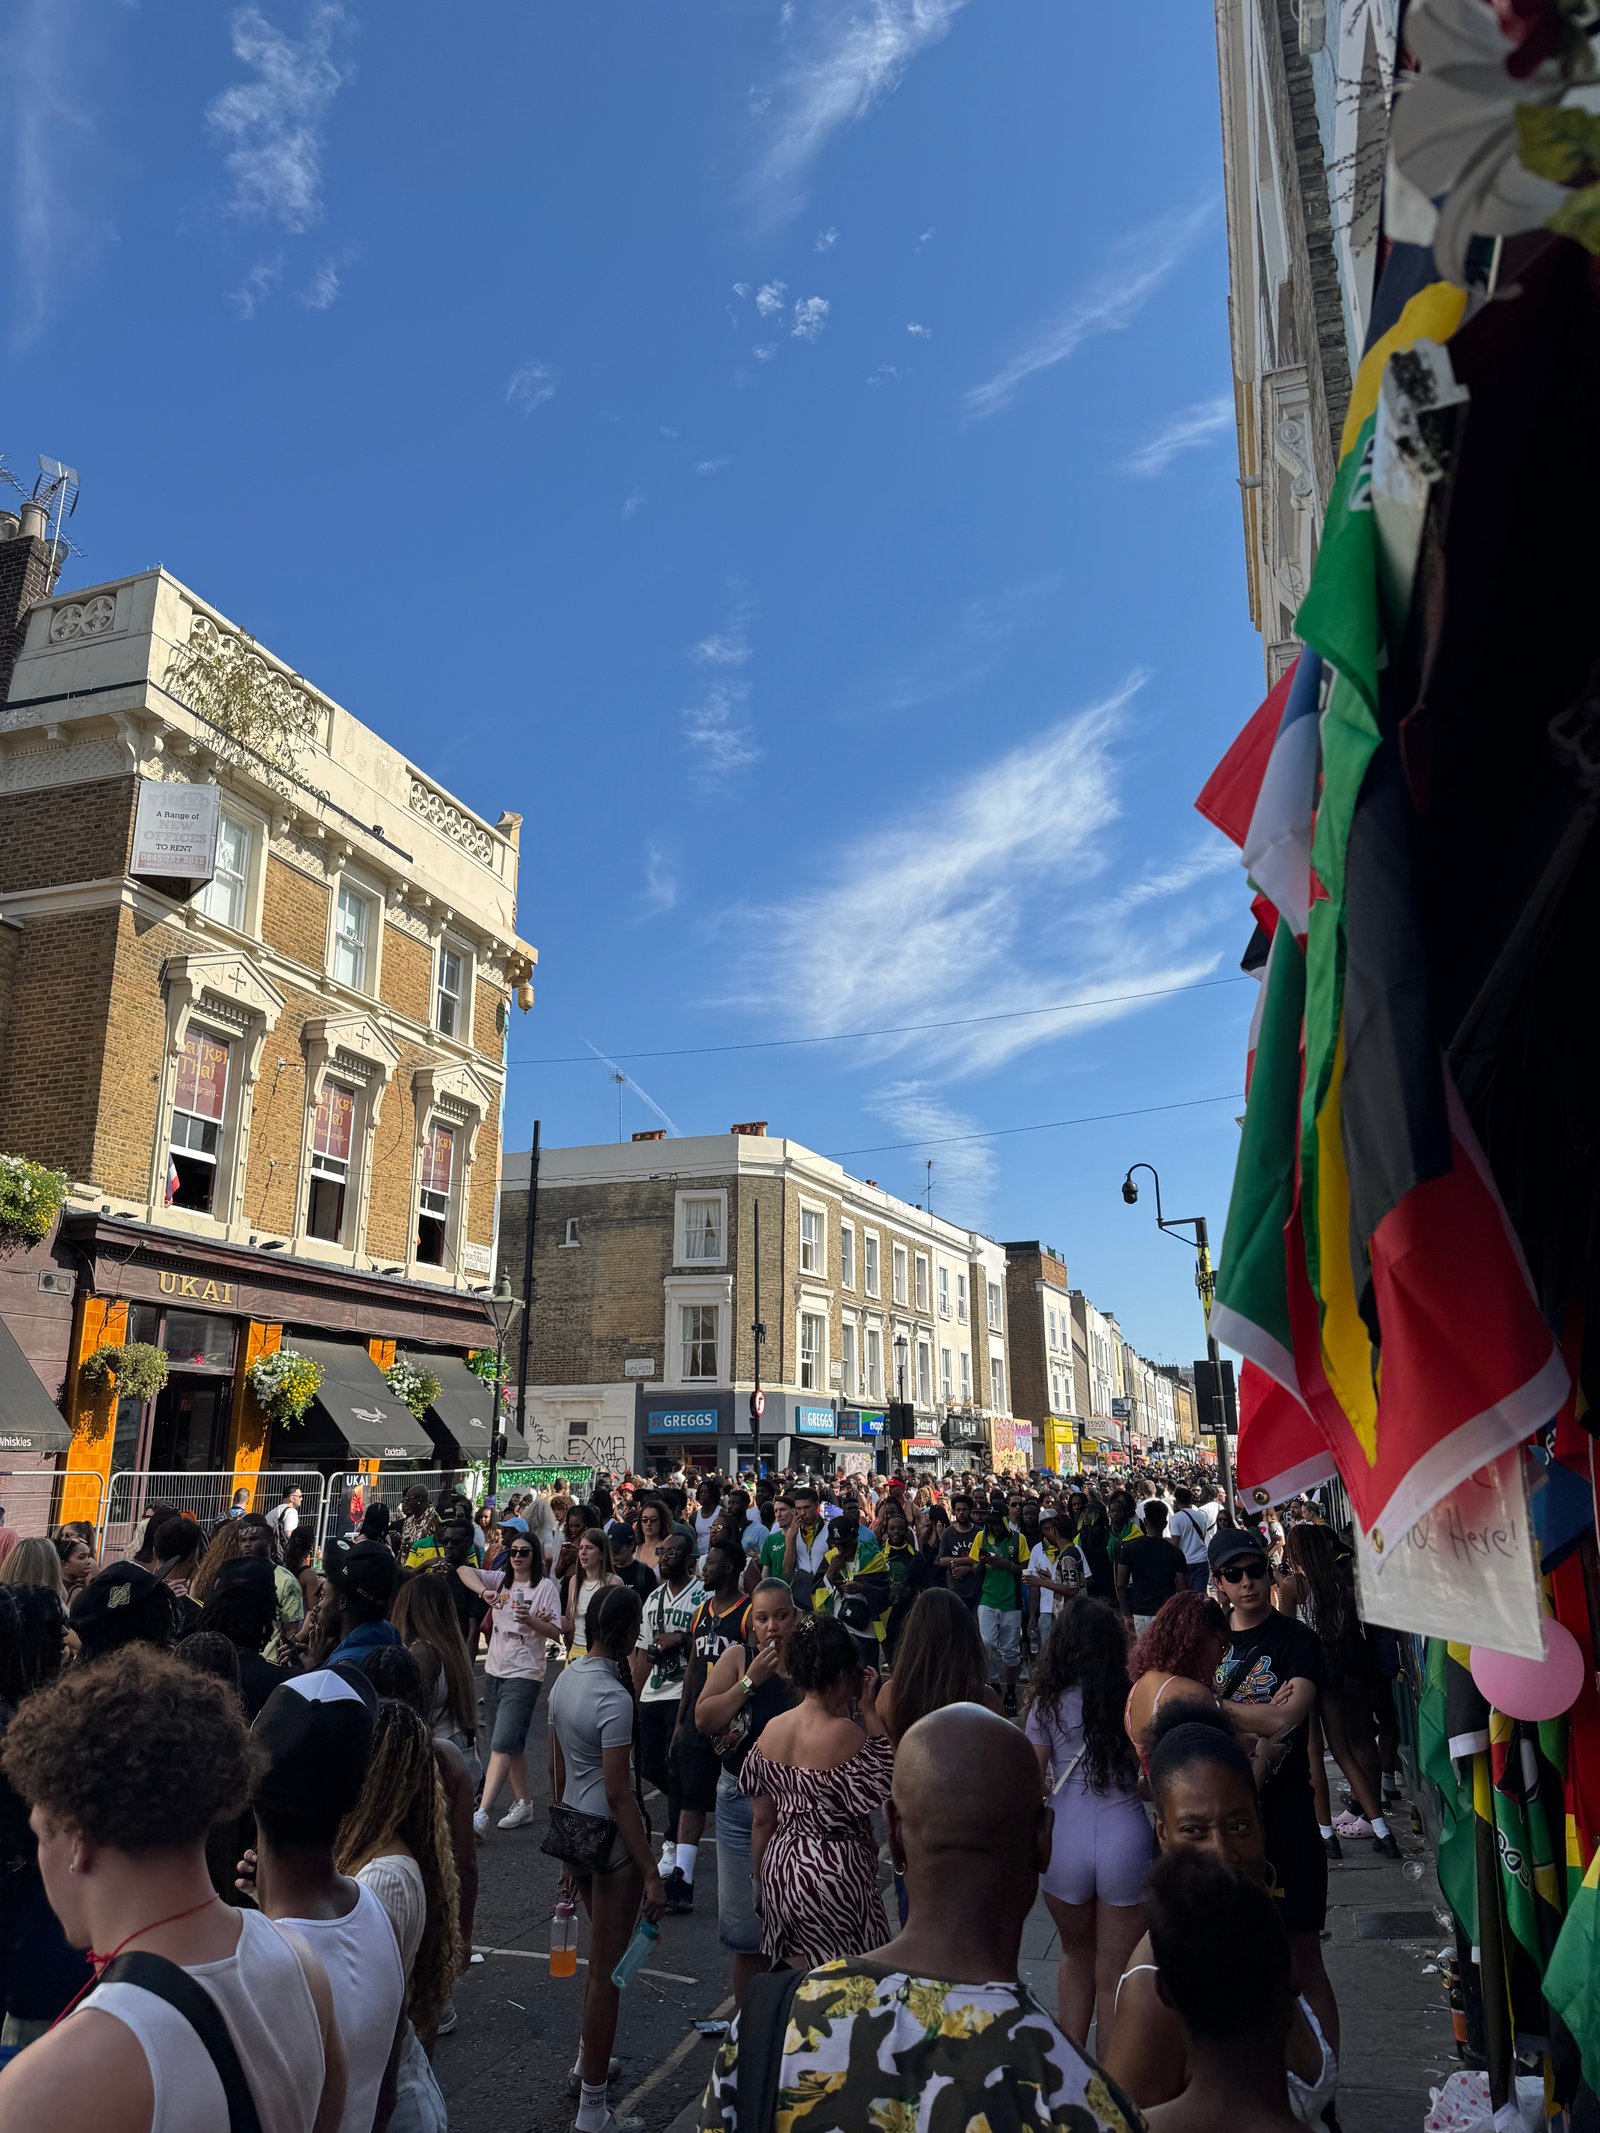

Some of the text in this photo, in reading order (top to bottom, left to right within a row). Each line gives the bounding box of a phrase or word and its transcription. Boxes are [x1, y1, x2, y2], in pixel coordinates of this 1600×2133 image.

[164, 811, 190, 820] Range
[158, 820, 195, 831] NEW
[143, 830, 207, 844] OFFICES
[156, 843, 193, 852] TO RENT
[466, 1252, 490, 1265] PORTOBELLO
[466, 1260, 478, 1269] ROAD
[158, 1270, 233, 1304] UKAI
[663, 1413, 713, 1427] GREGGS
[807, 1411, 833, 1428] GREGGS
[384, 1447, 408, 1457] Cocktails
[346, 1474, 369, 1486] UKAI
[1447, 1503, 1520, 1567] Here!
